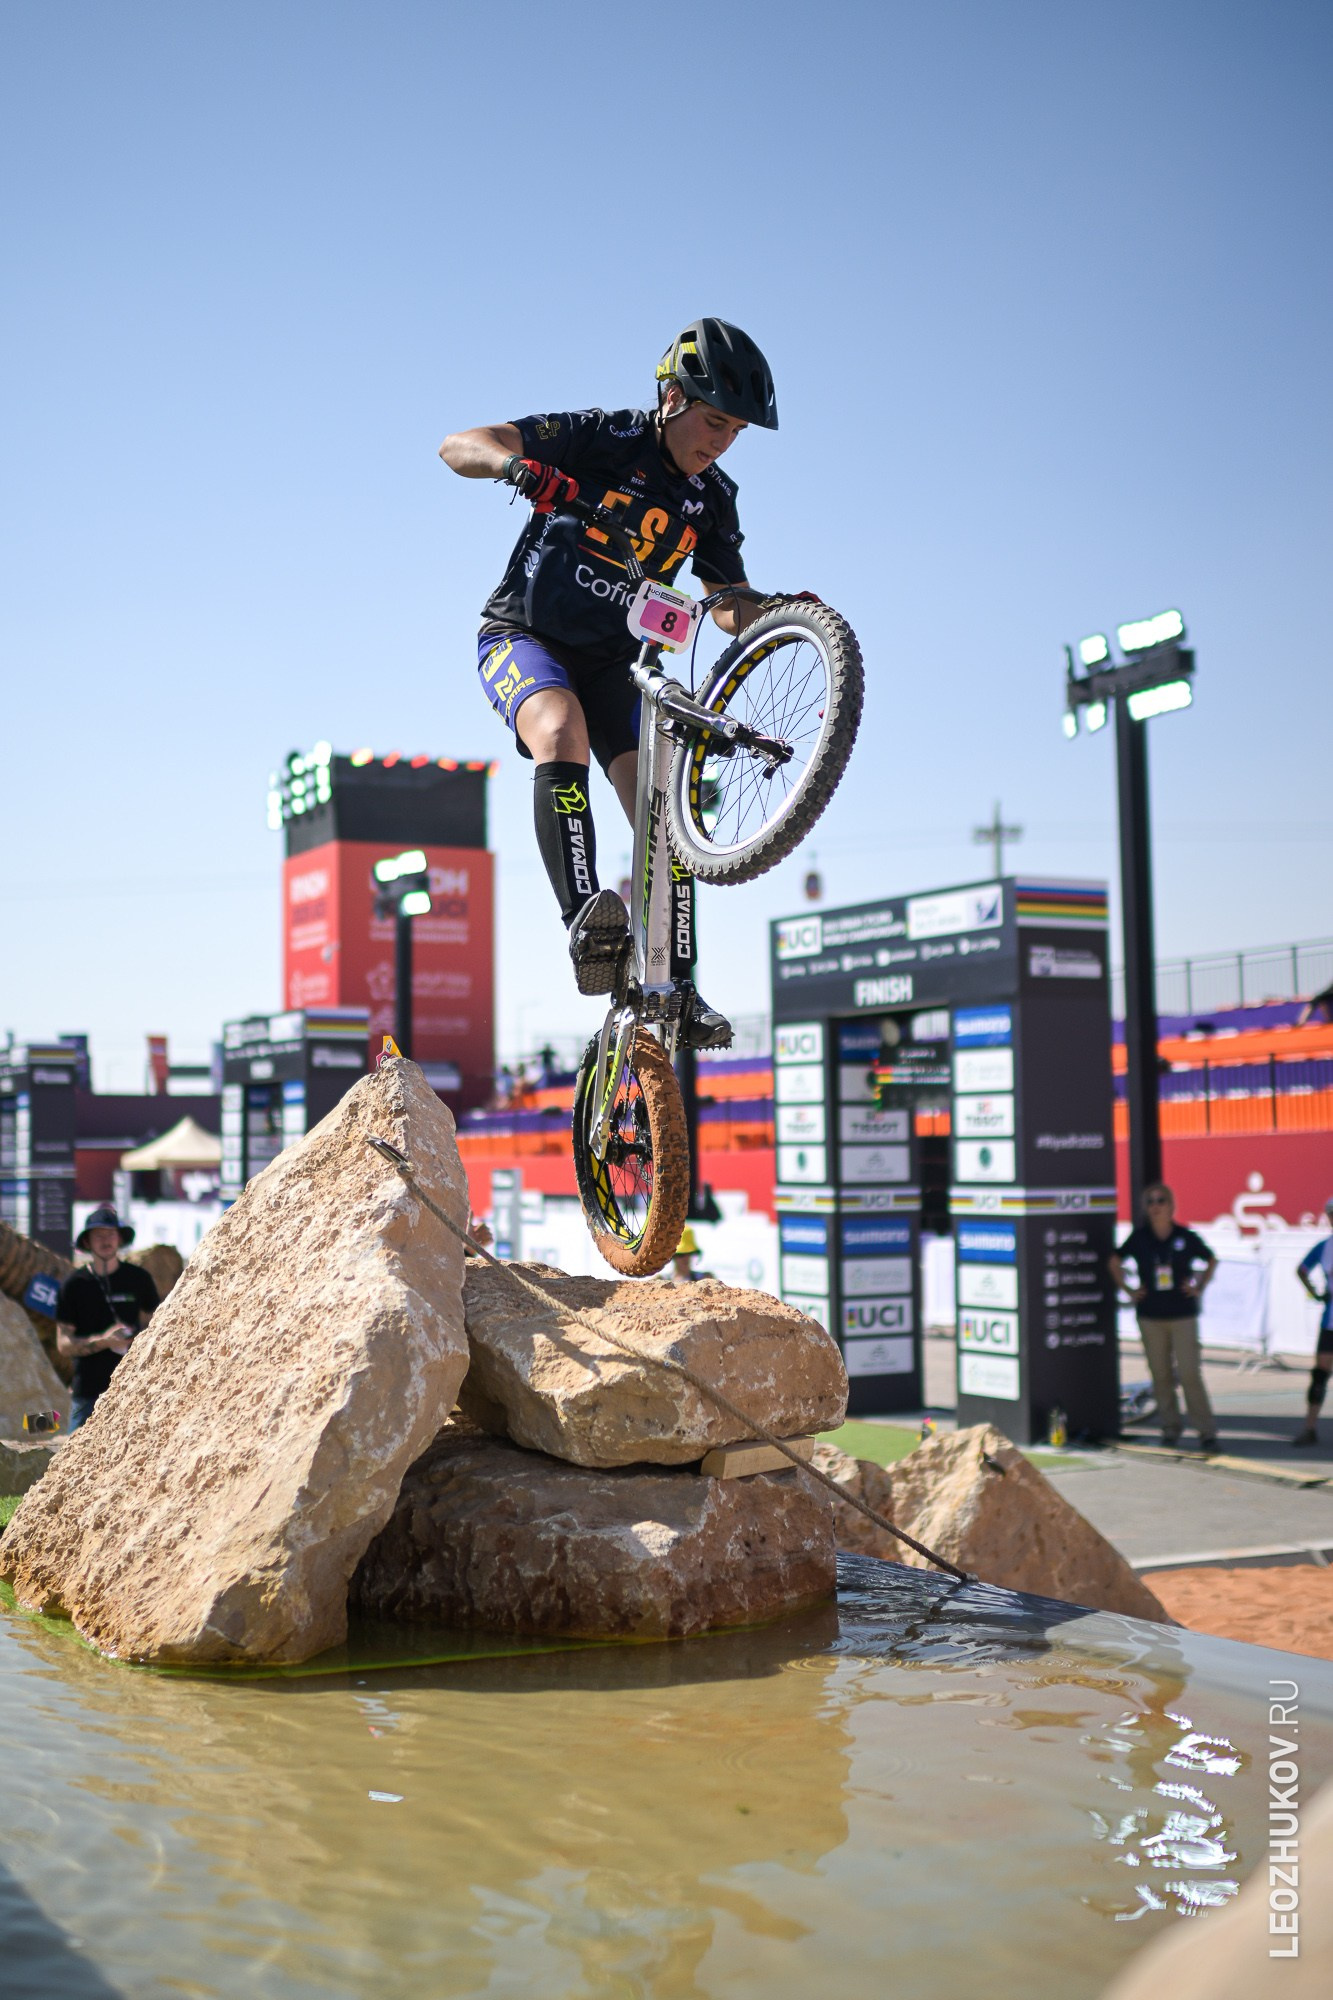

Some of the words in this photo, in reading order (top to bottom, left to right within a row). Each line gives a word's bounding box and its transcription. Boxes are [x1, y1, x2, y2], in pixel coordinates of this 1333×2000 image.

[661, 611, 678, 633] 8
[568, 818, 592, 895] COMAS
[676, 885, 691, 959] COMAS
[788, 927, 817, 949] UCI
[855, 975, 913, 1007] FINISH
[787, 1033, 815, 1056] UCI
[863, 1193, 890, 1207] UCI
[1056, 1192, 1088, 1209] UCI
[858, 1304, 904, 1329] UCI
[972, 1319, 1010, 1345] UCI
